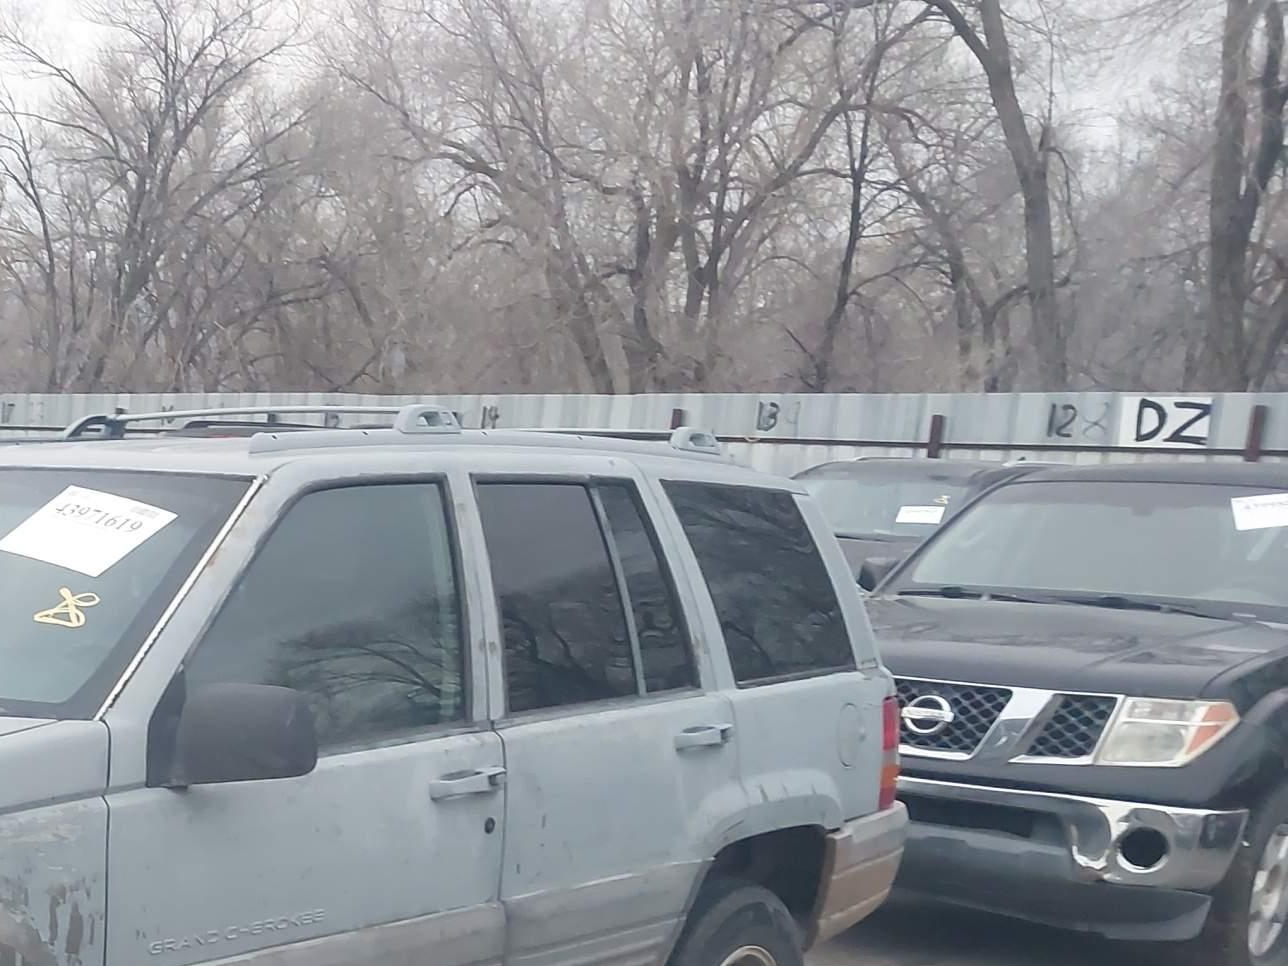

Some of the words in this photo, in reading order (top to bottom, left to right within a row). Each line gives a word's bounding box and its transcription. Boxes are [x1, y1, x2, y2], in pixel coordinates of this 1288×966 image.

[1046, 402, 1078, 438] 12
[1135, 397, 1211, 445] DZ
[55, 503, 143, 532] 43971619
[148, 930, 219, 955] GRAND
[225, 908, 325, 940] CHEROKEE
